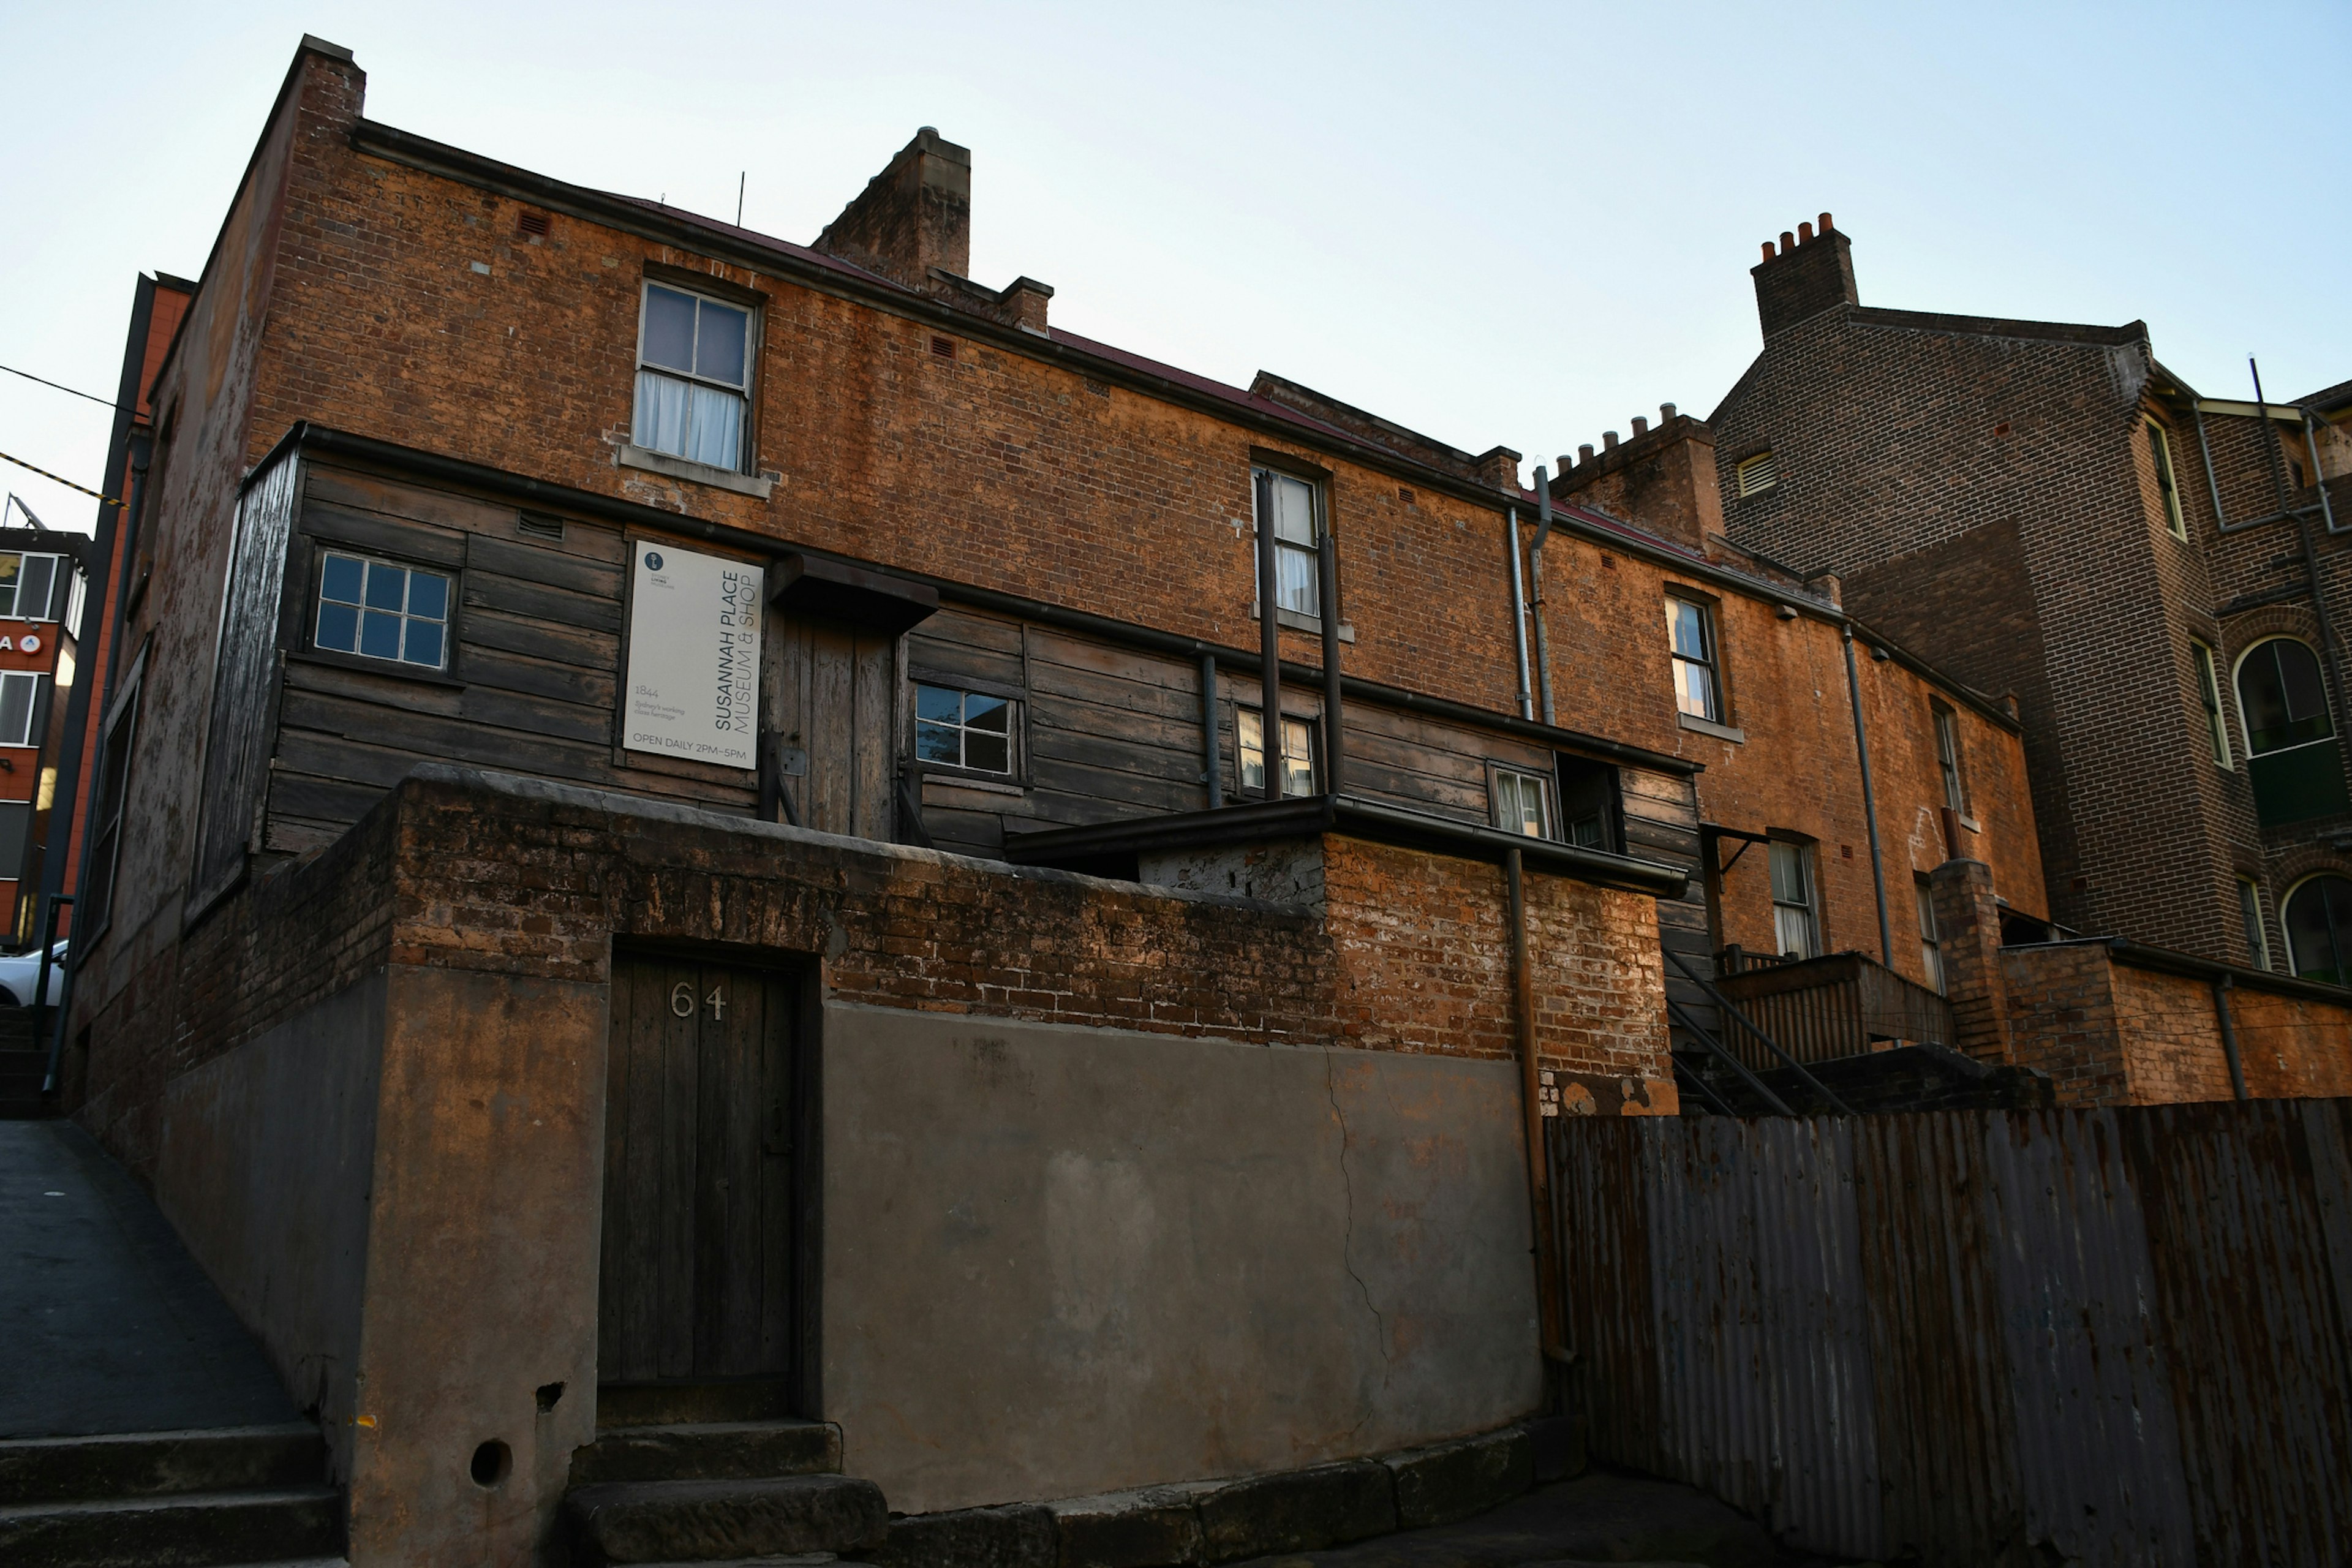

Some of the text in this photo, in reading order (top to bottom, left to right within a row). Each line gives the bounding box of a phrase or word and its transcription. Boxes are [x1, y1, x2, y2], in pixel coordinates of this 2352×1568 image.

[716, 570, 737, 731] SUSANNAH PLACE
[734, 575, 755, 734] MUSEUM & SHOP
[635, 685, 659, 698] 1844
[633, 733, 663, 746] OPEN
[666, 738, 693, 750] DAILY
[671, 981, 726, 1021] 64
